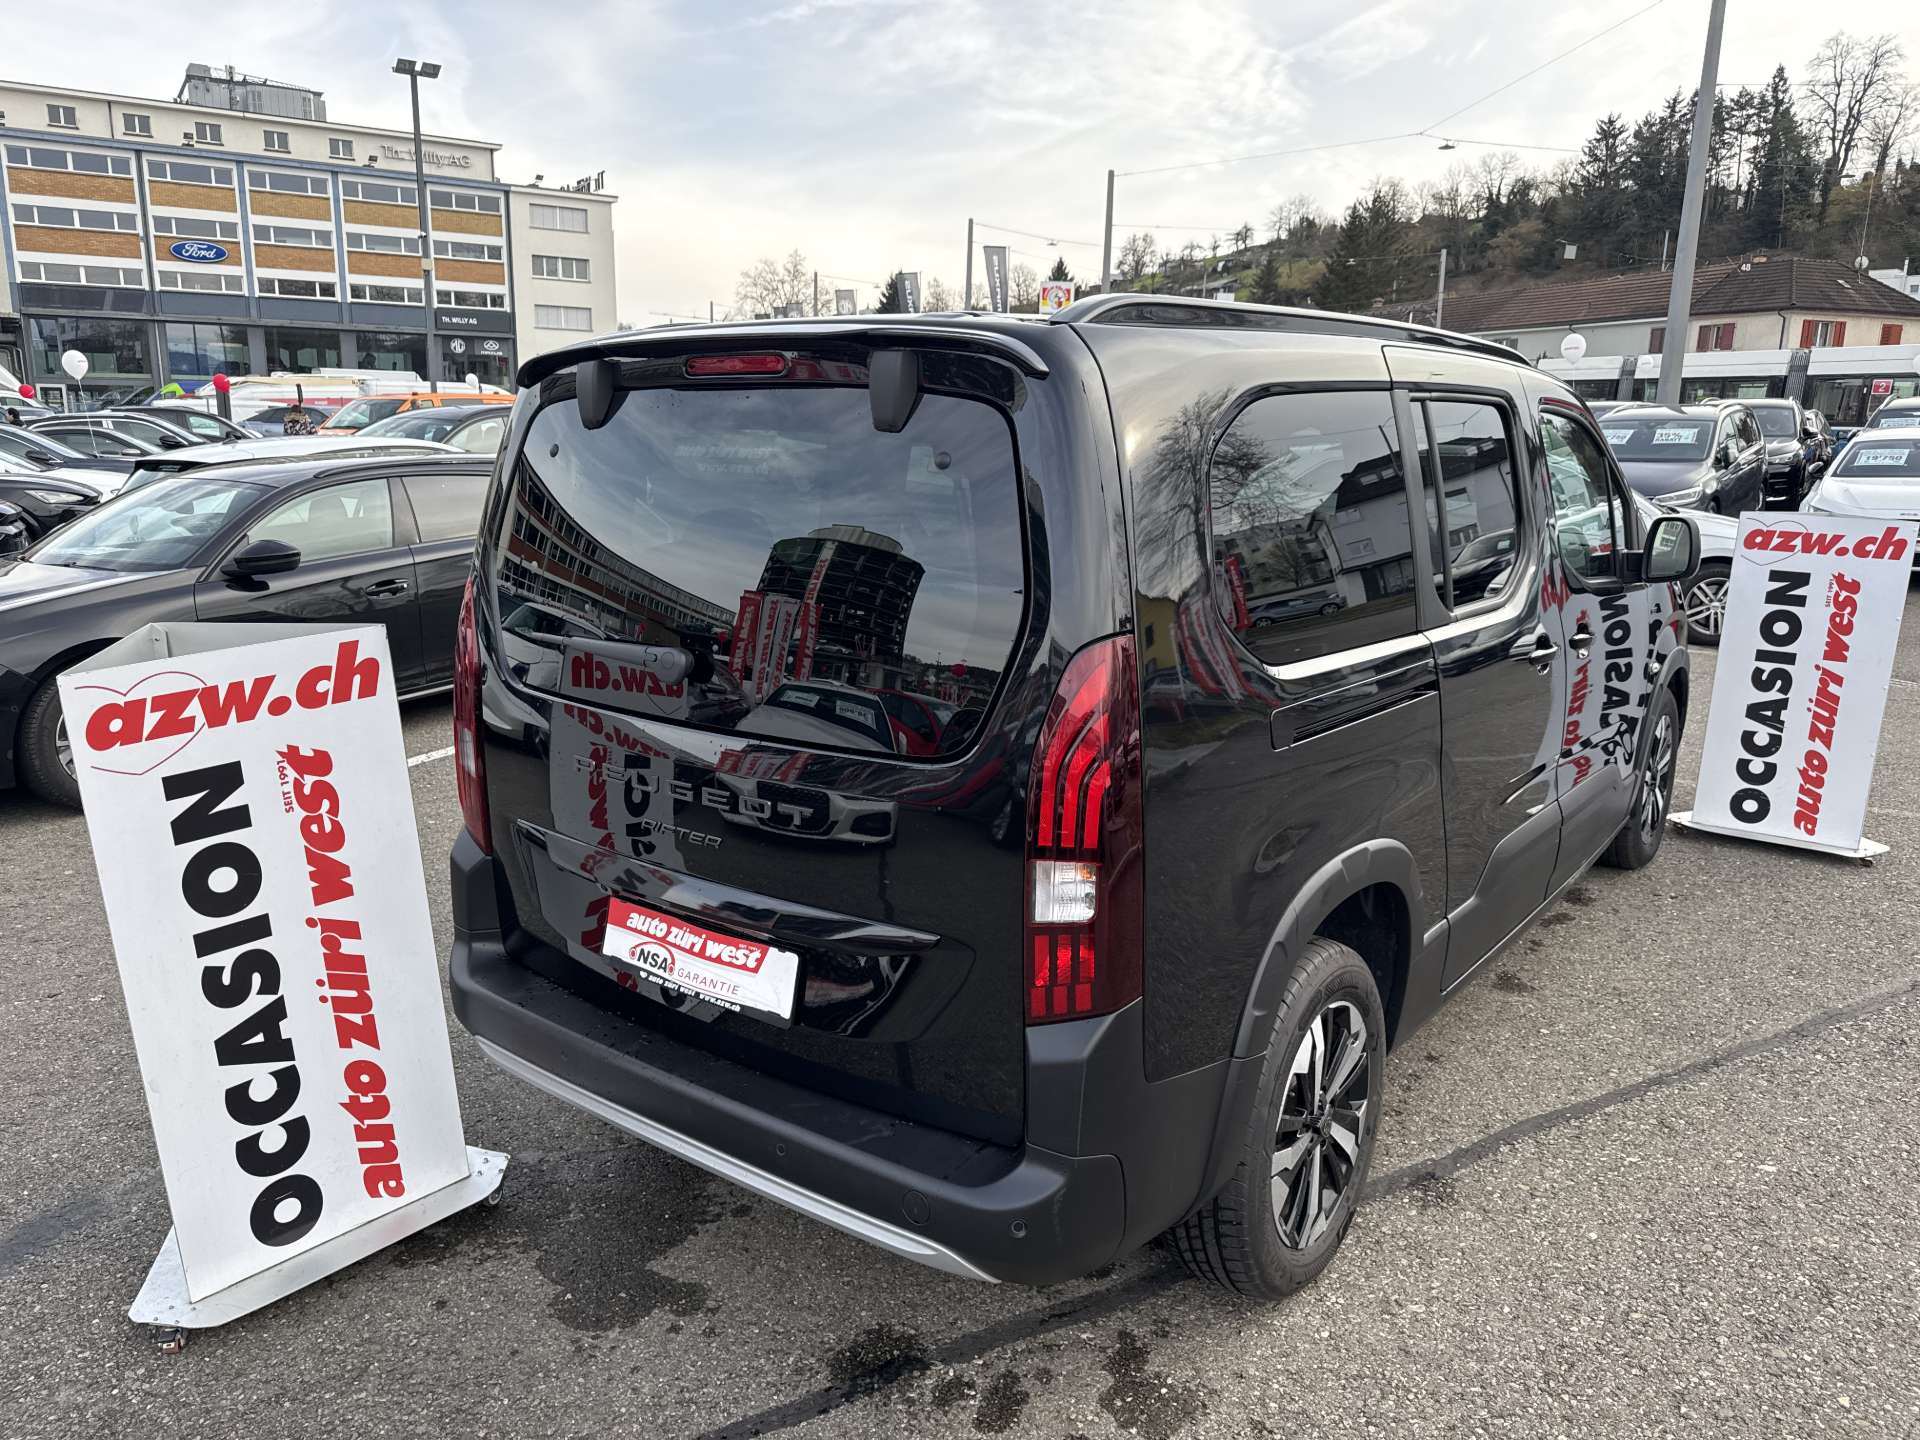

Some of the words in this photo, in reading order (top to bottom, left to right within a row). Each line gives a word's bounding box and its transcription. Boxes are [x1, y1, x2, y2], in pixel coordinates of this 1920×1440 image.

[182, 243, 216, 258] Ford
[451, 317, 468, 325] WILLY
[1878, 382, 1886, 392] 2
[1743, 526, 1909, 562] azw.ch
[1824, 572, 1861, 663] west
[86, 640, 380, 752] azw.ch
[1730, 569, 1812, 824] OCCASION
[1808, 664, 1845, 752] züri
[282, 791, 295, 814] SEIT
[574, 753, 816, 828] PEUGEOT
[1794, 753, 1830, 836] auto
[278, 744, 354, 906] west
[640, 818, 723, 849] RIFTER
[626, 911, 668, 938] auto
[664, 926, 706, 957] züri
[704, 940, 762, 969] west
[636, 948, 669, 974] NSA
[161, 760, 324, 1247] OCCASION
[306, 916, 379, 1051] züri
[648, 973, 665, 988] auto
[679, 985, 696, 997] west
[699, 991, 742, 1013] www.azw.ch
[677, 967, 741, 996] GARANTIE
[340, 1059, 405, 1199] auto
